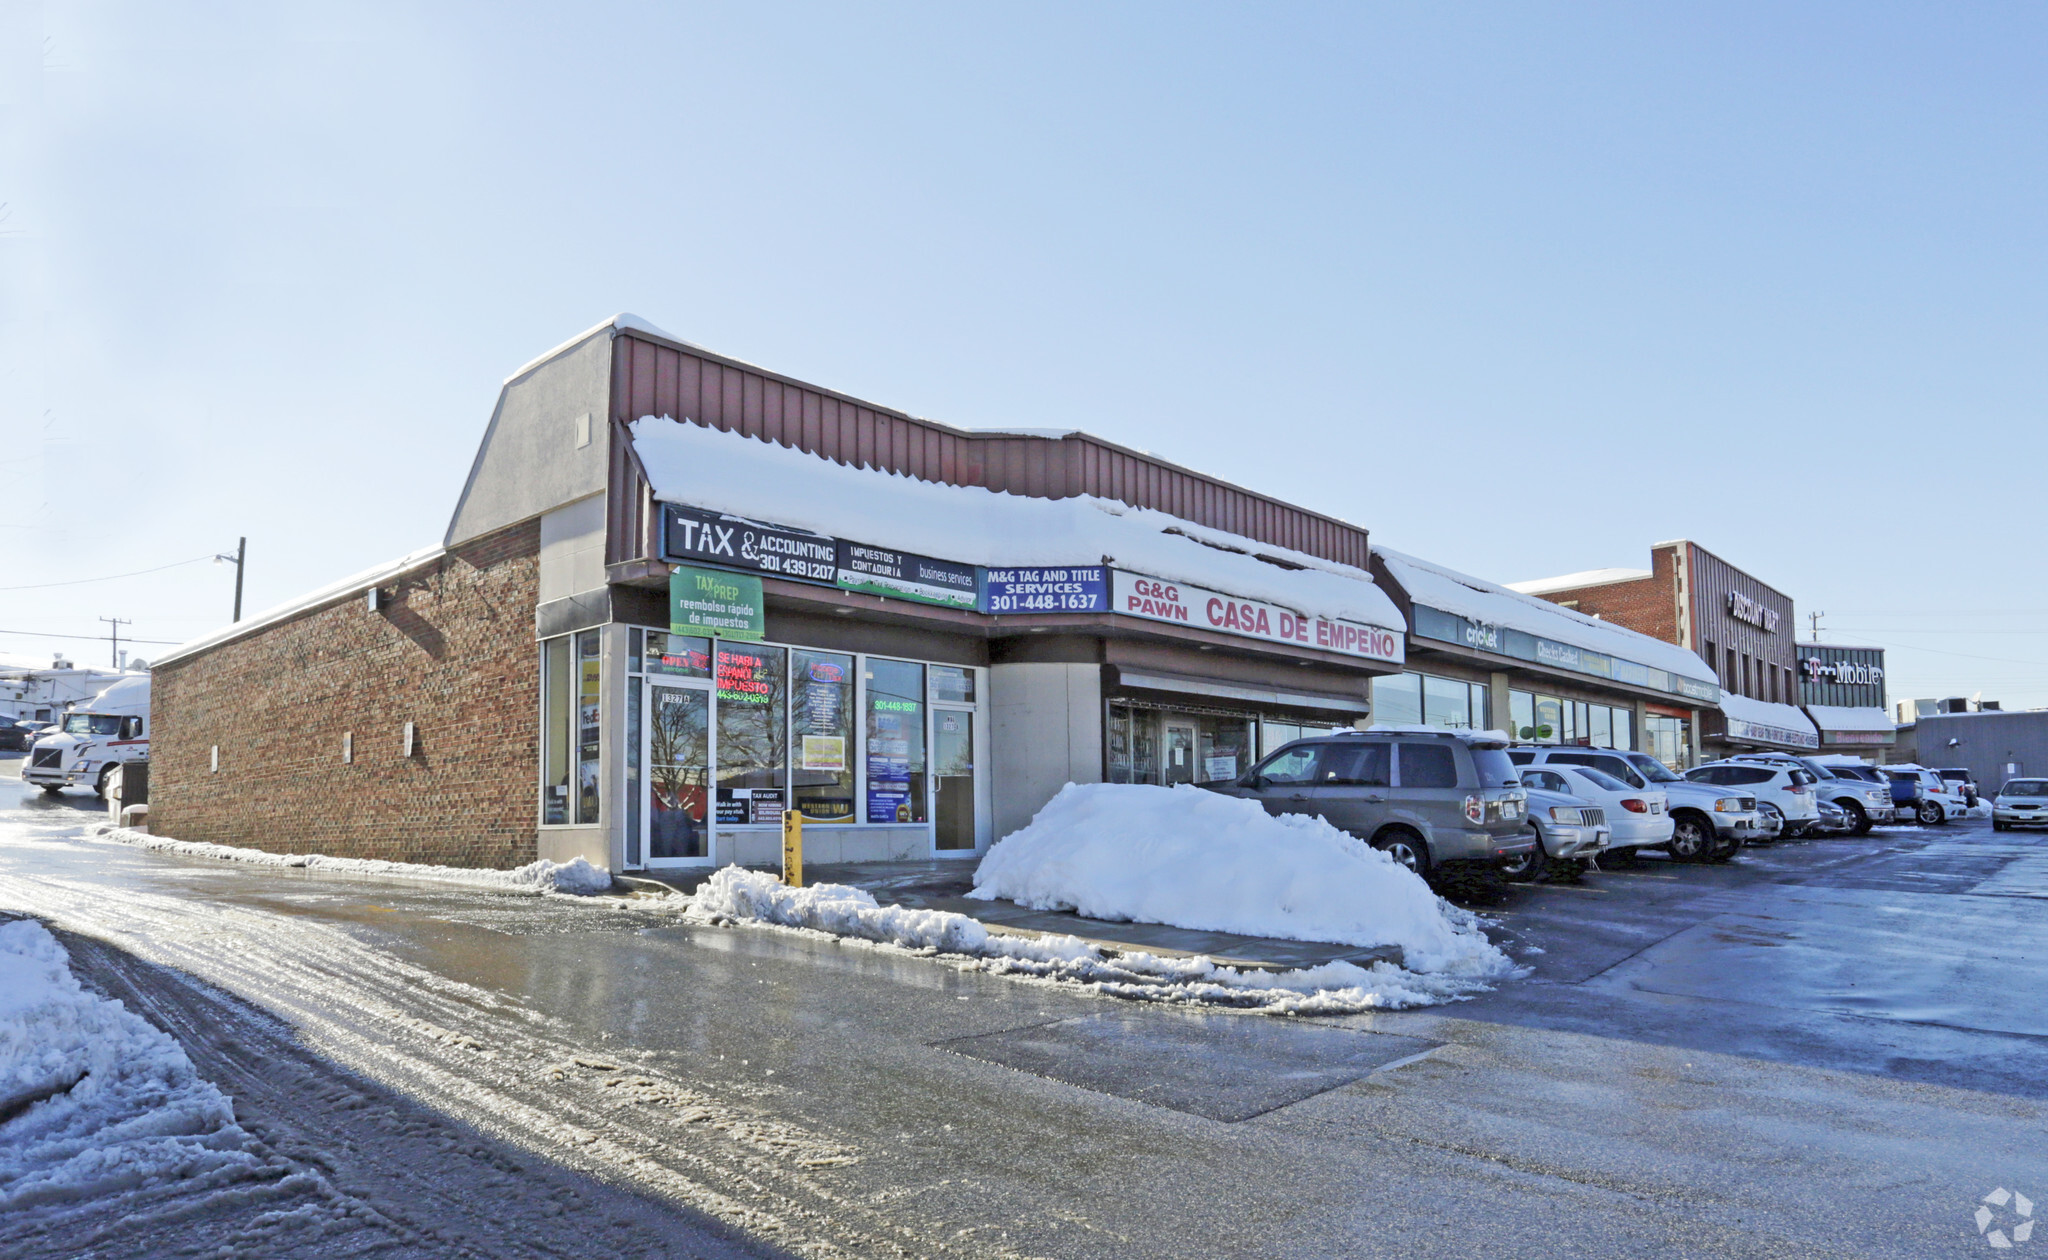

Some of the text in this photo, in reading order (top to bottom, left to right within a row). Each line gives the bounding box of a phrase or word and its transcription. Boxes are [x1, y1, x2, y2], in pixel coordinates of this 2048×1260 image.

[677, 517, 834, 562] TAX & ACCOUNTING
[760, 553, 780, 571] 301
[850, 546, 902, 565] IMPUESTOS Y
[852, 560, 902, 578] CONTADURIA
[919, 563, 973, 587] business services
[988, 569, 1100, 583] M&G TAG AND TITLE
[695, 575, 739, 600] TAX PREP
[1005, 583, 1083, 594] SERVICES
[1134, 579, 1179, 602] G&G
[680, 599, 754, 617] reembolso rápido
[991, 594, 1098, 610] 301-448-1637
[1127, 595, 1188, 621] PAWN
[689, 611, 749, 629] de impuestos
[1206, 597, 1395, 658] CASA DE EMPEÑO
[1466, 627, 1498, 648] cricket
[662, 656, 689, 668] OPEN
[718, 652, 730, 664] SE
[1834, 660, 1883, 685] Mobile
[716, 677, 769, 694] IMPUESTO
[1836, 731, 1883, 743] Bienvenido
